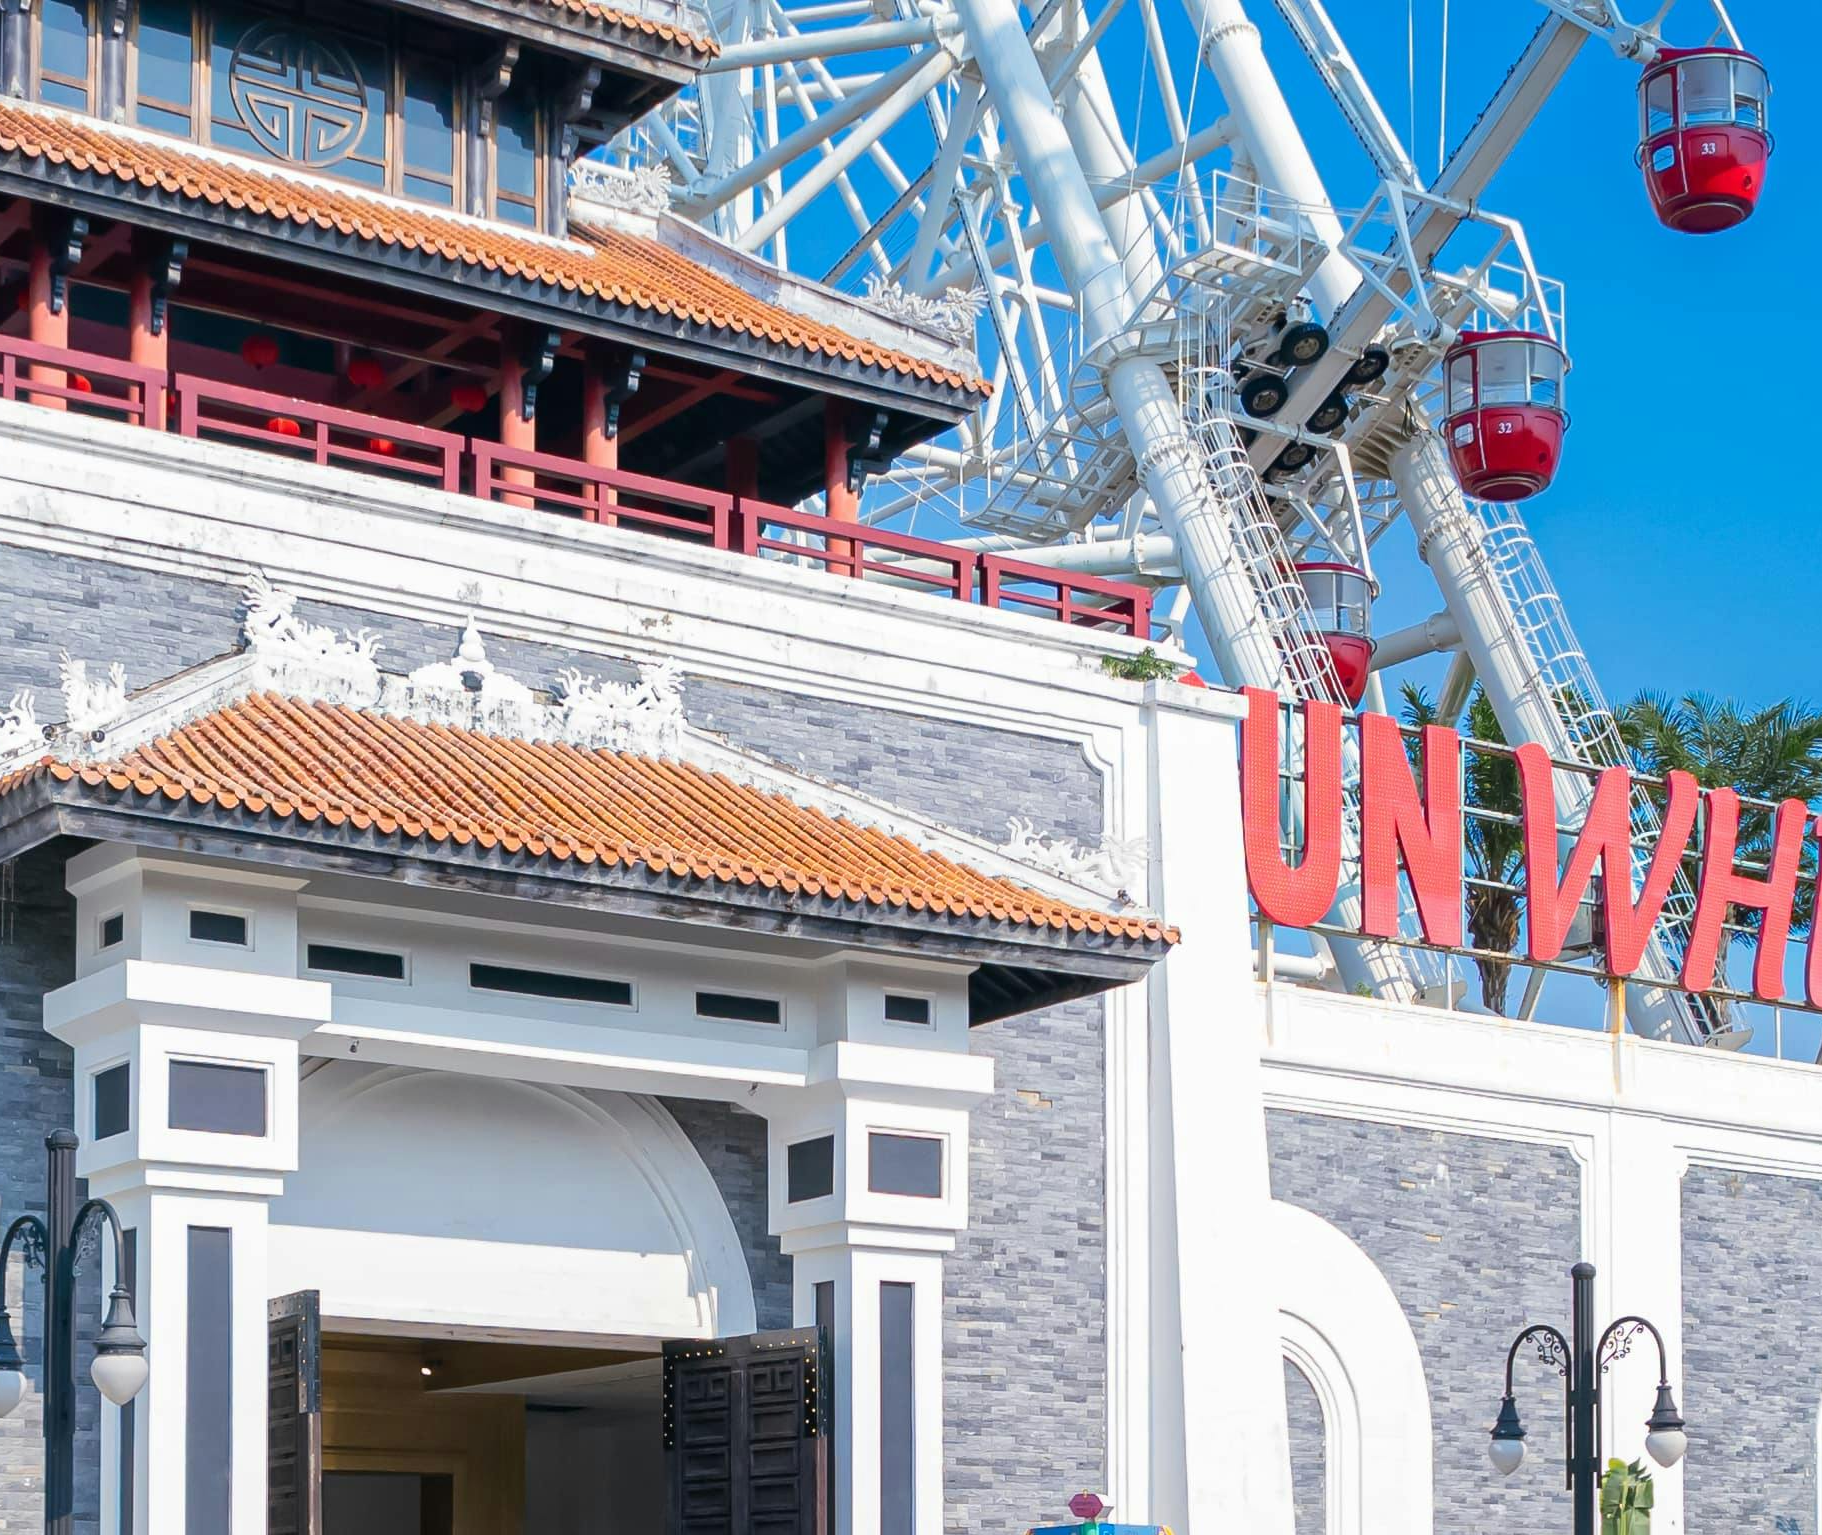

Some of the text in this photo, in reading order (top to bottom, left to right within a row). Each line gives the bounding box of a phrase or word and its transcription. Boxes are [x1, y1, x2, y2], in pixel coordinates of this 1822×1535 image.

[1701, 142, 1716, 155] 33
[1498, 422, 1512, 434] 32
[1178, 670, 1461, 947] UN
